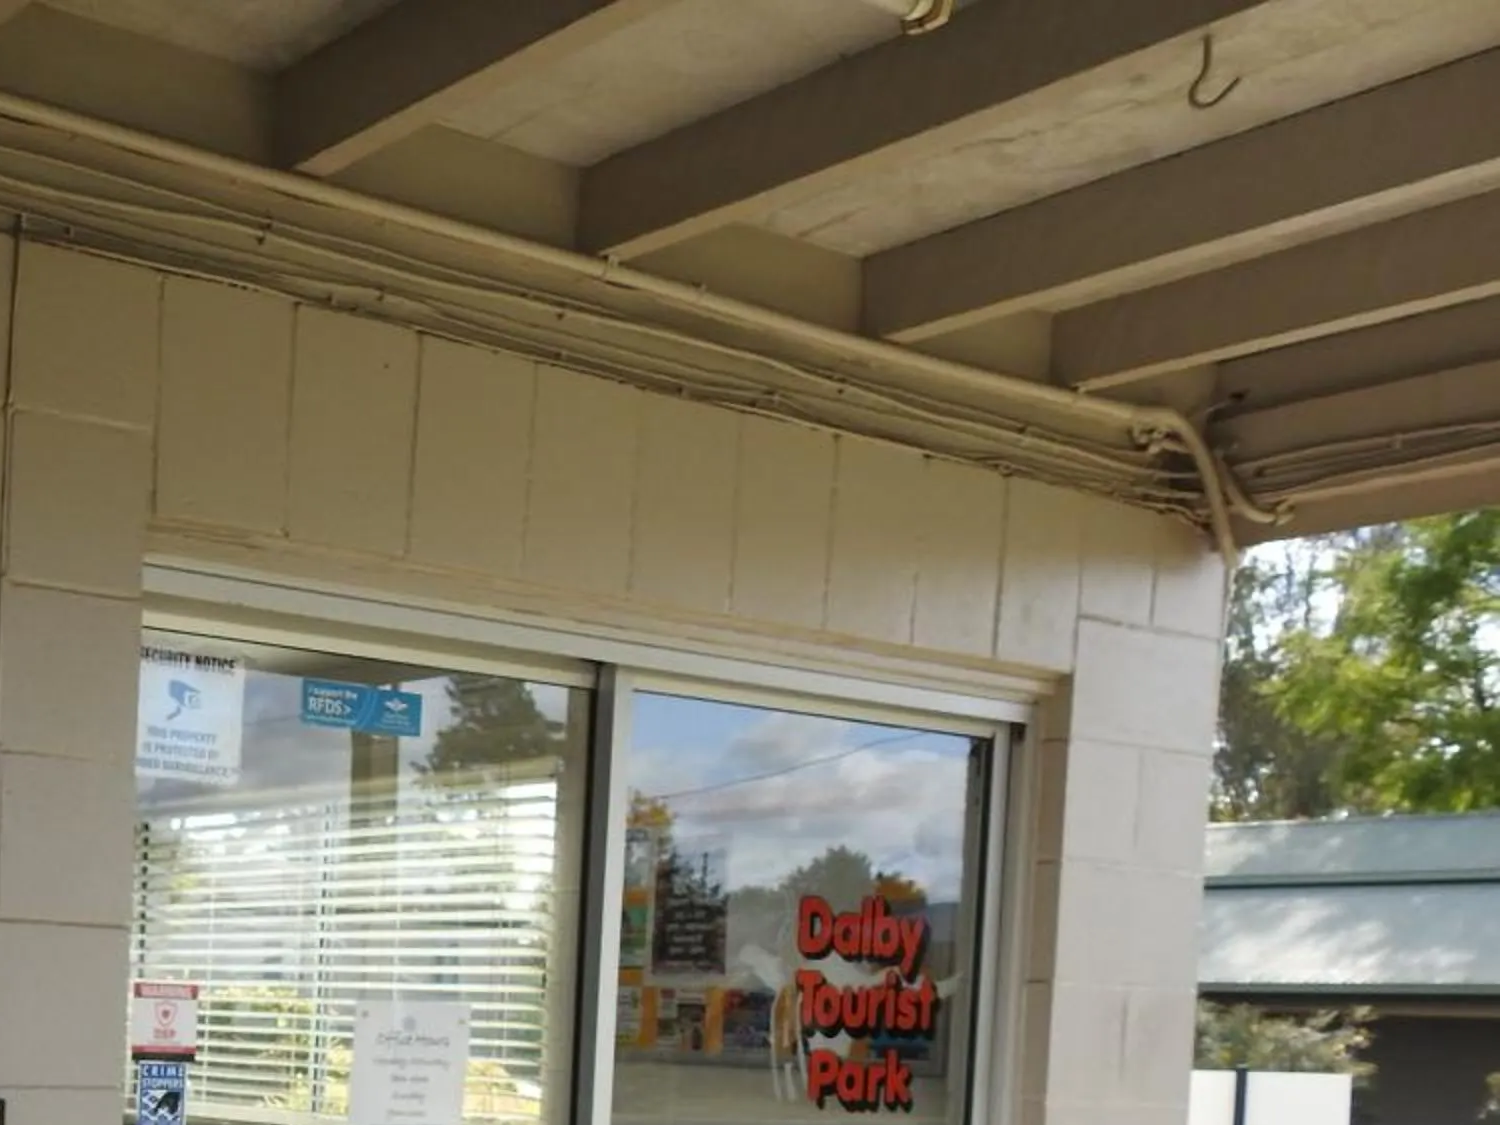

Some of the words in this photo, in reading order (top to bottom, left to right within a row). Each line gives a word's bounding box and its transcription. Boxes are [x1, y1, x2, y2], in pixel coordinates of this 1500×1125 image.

[797, 894, 928, 976] Dalby
[797, 968, 936, 1035] Tourist
[143, 1066, 183, 1077] CRIME
[807, 1050, 914, 1112] Park
